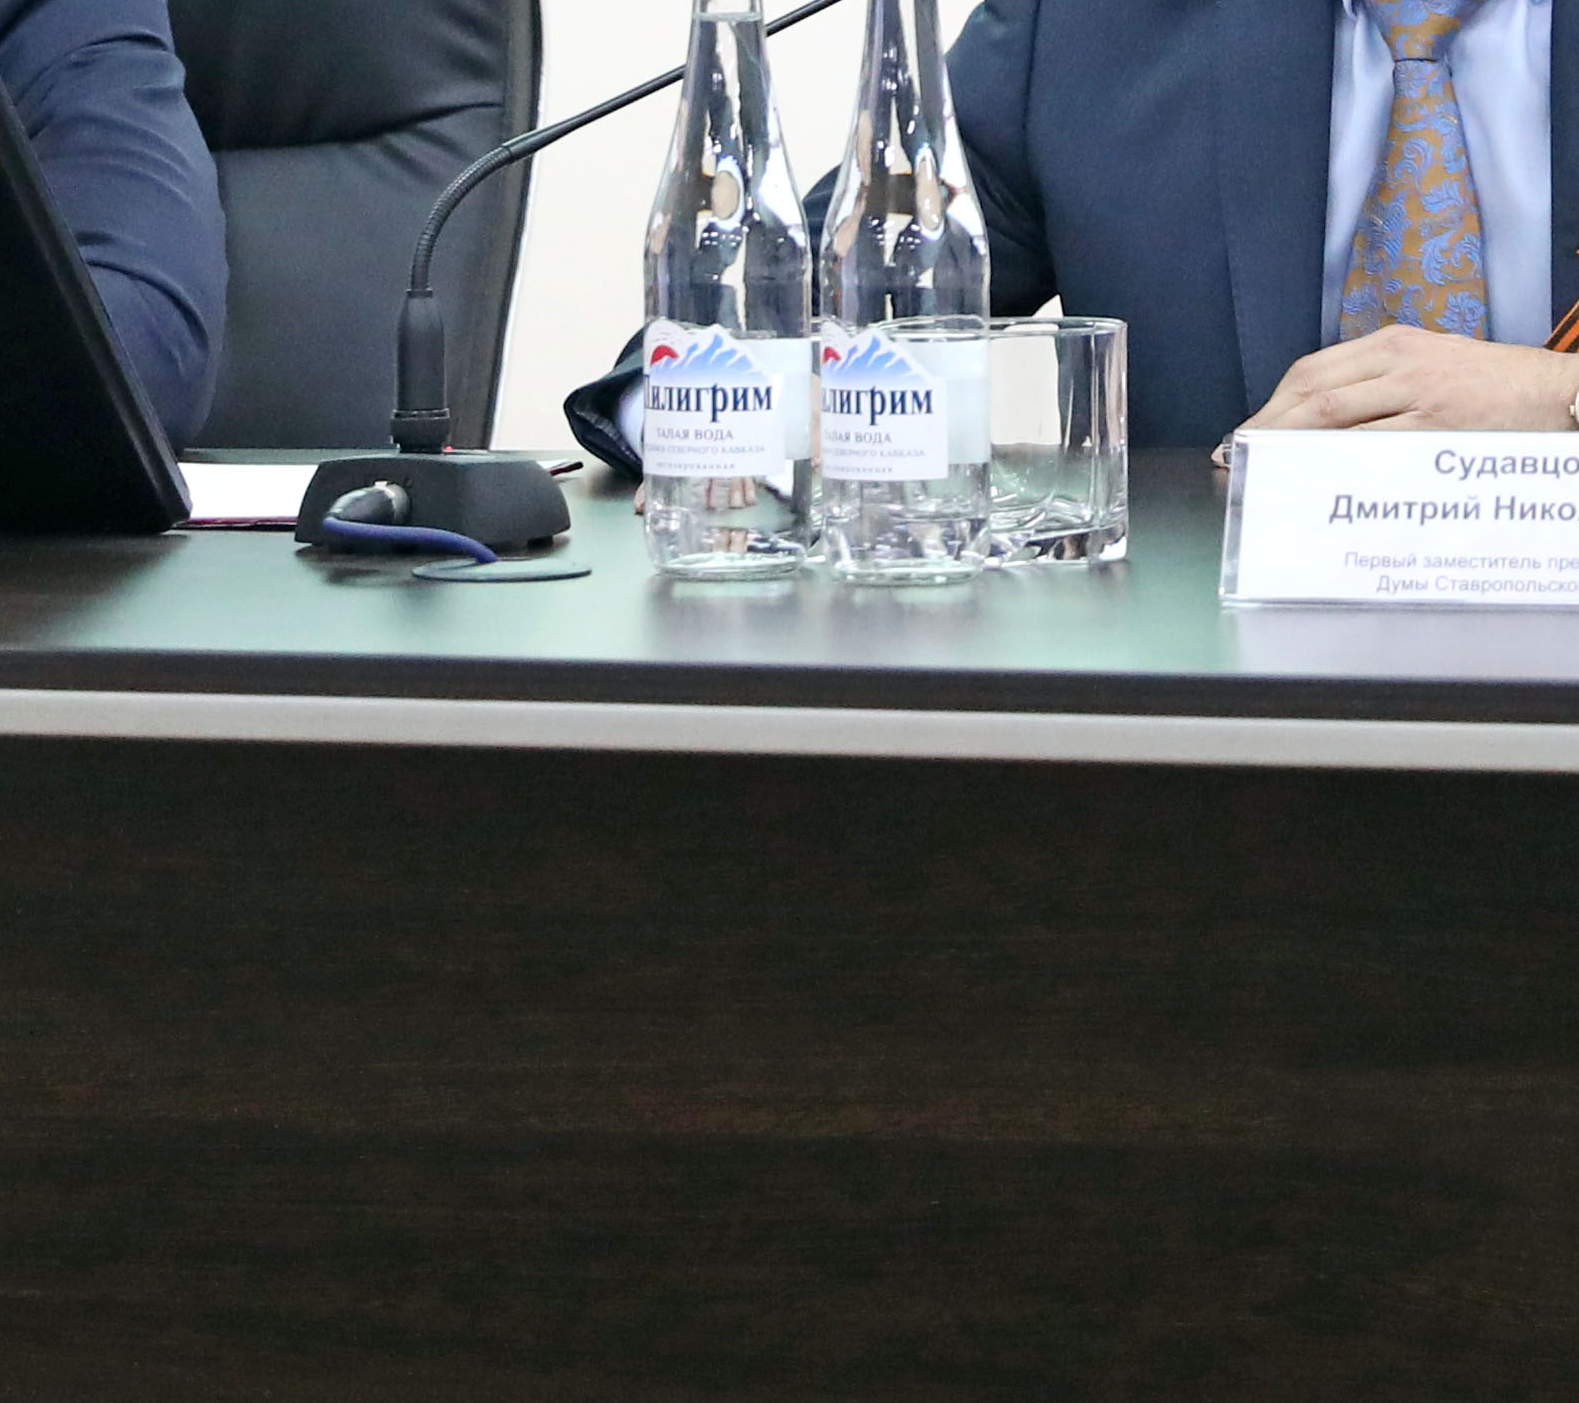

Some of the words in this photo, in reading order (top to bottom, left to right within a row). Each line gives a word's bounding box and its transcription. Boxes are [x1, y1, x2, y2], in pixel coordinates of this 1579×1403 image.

[656, 428, 690, 440] ТАЛАЯ
[694, 429, 734, 442] ВОДА
[855, 432, 892, 444] ВОДА
[1328, 493, 1481, 526] Дмитрий
[1343, 552, 1418, 570] Первый
[1422, 556, 1542, 571] заместитель
[1375, 575, 1429, 594] Думы
